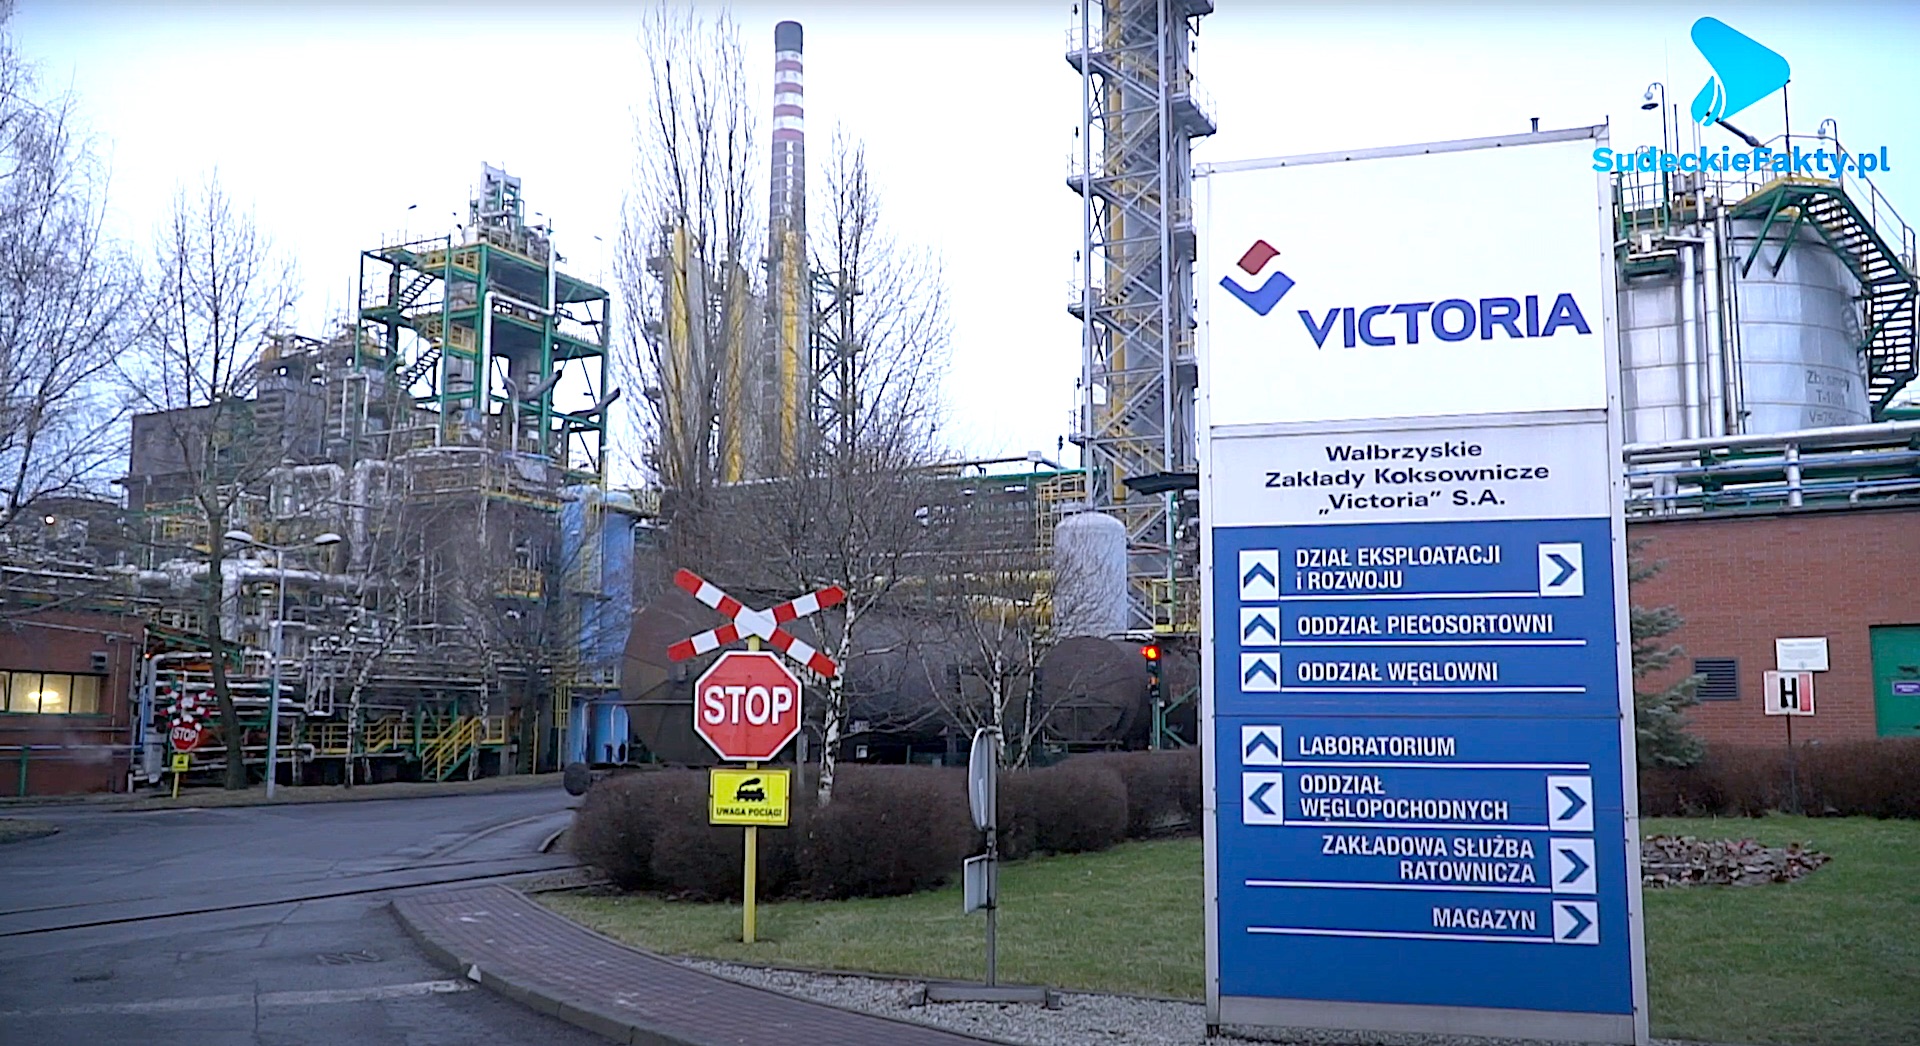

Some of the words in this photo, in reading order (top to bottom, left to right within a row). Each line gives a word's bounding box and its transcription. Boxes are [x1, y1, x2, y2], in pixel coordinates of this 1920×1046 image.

[1298, 292, 1592, 349] VICTORIA
[1325, 441, 1482, 463] Wałbrzyskie
[1265, 468, 1365, 490] Zakłady
[1375, 465, 1549, 486] Koksownicze
[1318, 489, 1441, 515] „Victoria”
[1452, 489, 1506, 506] S.A.
[1296, 548, 1352, 568] DZIAŁ
[1357, 545, 1500, 566] EKSPLOATACJI
[1308, 569, 1402, 590] ROZWOJU
[1297, 616, 1382, 635] ODDZIAŁ
[1387, 614, 1553, 634] PIECOSORTOWNI
[1297, 662, 1383, 682] ODDZIAŁ
[1387, 661, 1498, 686] WĘGLOWNI
[1780, 677, 1798, 709] H
[703, 686, 793, 725] STOP
[173, 727, 196, 741] STOP
[1299, 736, 1455, 757] LABORATORIUM
[1300, 775, 1386, 795] ODDZIAŁ
[716, 807, 746, 816] UWAGA
[748, 808, 782, 819] POCIĄGI
[1300, 800, 1508, 823] WĘGLOPOCHODNYCH
[1322, 836, 1448, 857] ZAKŁADOWA
[1453, 834, 1534, 859] SŁUŻBA
[1400, 860, 1535, 883] RATOWNICZA
[1433, 907, 1536, 930] MAGAZYN
